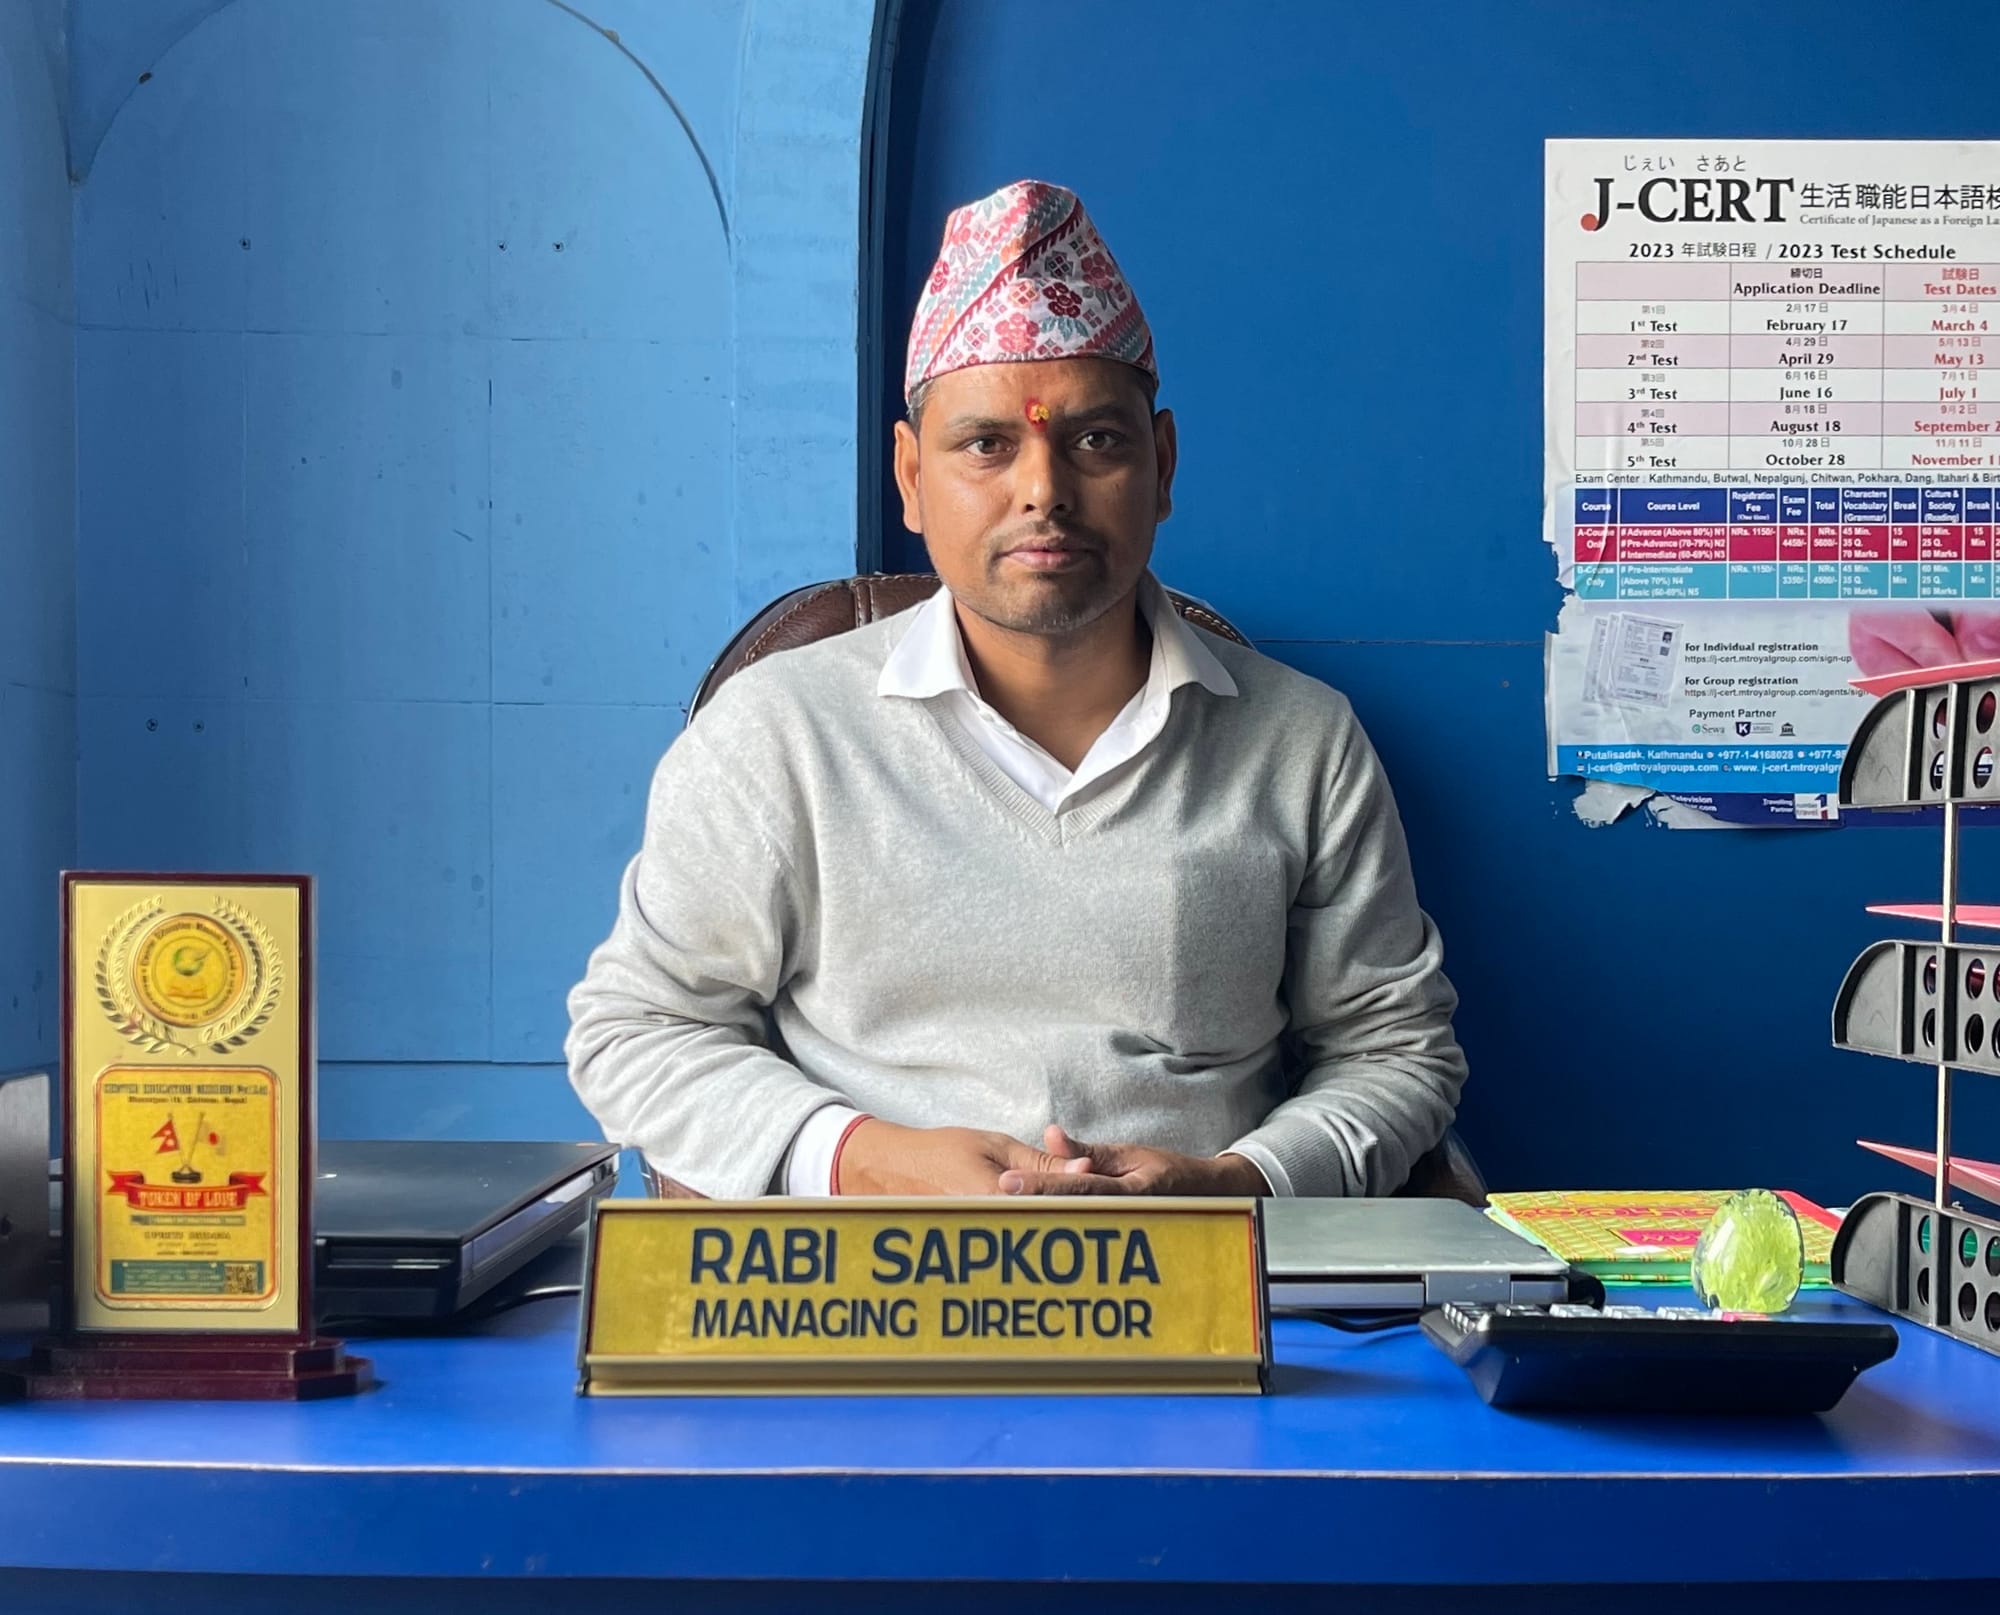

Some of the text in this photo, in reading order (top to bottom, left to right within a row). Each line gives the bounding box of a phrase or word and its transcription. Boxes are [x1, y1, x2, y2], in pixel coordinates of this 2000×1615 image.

[1624, 155, 1746, 172] じぇい さあと
[1593, 177, 1795, 231] J-CERT
[1800, 214, 1855, 225] Certificate
[1858, 214, 1869, 225] of
[1872, 215, 1917, 227] Japanese
[1943, 215, 1983, 228] Foreign
[1629, 243, 1674, 258] 2023
[1681, 242, 1756, 258] 年試験日程
[1779, 243, 1823, 259] 2023
[1831, 243, 1866, 259] Test
[1873, 244, 1956, 259] Schedule
[1733, 283, 1881, 296] Application Deadline
[1924, 284, 1997, 295] Test Dates
[1650, 321, 1677, 332] Test
[1766, 320, 1847, 334] February 17
[1931, 320, 1988, 331] March 4
[1651, 354, 1679, 366] Test
[1778, 353, 1834, 367] April 29
[1934, 354, 1984, 368] May 13
[1650, 388, 1677, 400] Test
[1780, 387, 1833, 400] June 16
[1940, 387, 1976, 401] July 1
[1650, 422, 1677, 433] Test
[1770, 421, 1841, 435] August 18
[1914, 421, 1990, 436] September
[1650, 456, 1677, 467] Test
[1766, 454, 1845, 466] October 28
[1912, 454, 1983, 466] November
[1575, 473, 1603, 483] Exam
[1607, 473, 1640, 483] Center
[1650, 473, 1710, 485] Kathmandu,
[1713, 473, 1750, 485] Butwal,
[1754, 473, 1808, 485] Nepalgunj,
[1811, 472, 1854, 485] Chitwan,
[1858, 473, 1902, 485] Pokhara,
[1905, 473, 1935, 485] Dang,
[1938, 473, 1969, 483] Itahari
[1972, 473, 1979, 483] &
[1732, 491, 1775, 502] Registration
[1843, 489, 1887, 498] Characters
[1924, 490, 1951, 498] Culture
[1783, 496, 1806, 504] Exam
[1815, 501, 1835, 510] Total
[1893, 501, 1917, 510] Break
[1582, 502, 1611, 511] Course
[1647, 502, 1700, 511] Course Level
[1745, 503, 1761, 512] Fee
[1786, 507, 1801, 516] Fee
[1843, 501, 1888, 511] Vocabulary
[1928, 502, 1956, 512] Society
[1967, 502, 1990, 510] Break
[1627, 528, 1662, 536] Advance
[1663, 528, 1692, 537] (Above
[1627, 539, 1678, 548] Pre-Advance
[1685, 643, 1818, 653] For Individual registration
[1685, 676, 1798, 687] For Group registration
[1689, 709, 1776, 720] Payment Partner
[1648, 750, 1703, 760] Kathmandu
[690, 1227, 1161, 1285] RABI SAPKOTA
[692, 1298, 1153, 1338] MANAGING DIRECTOR
